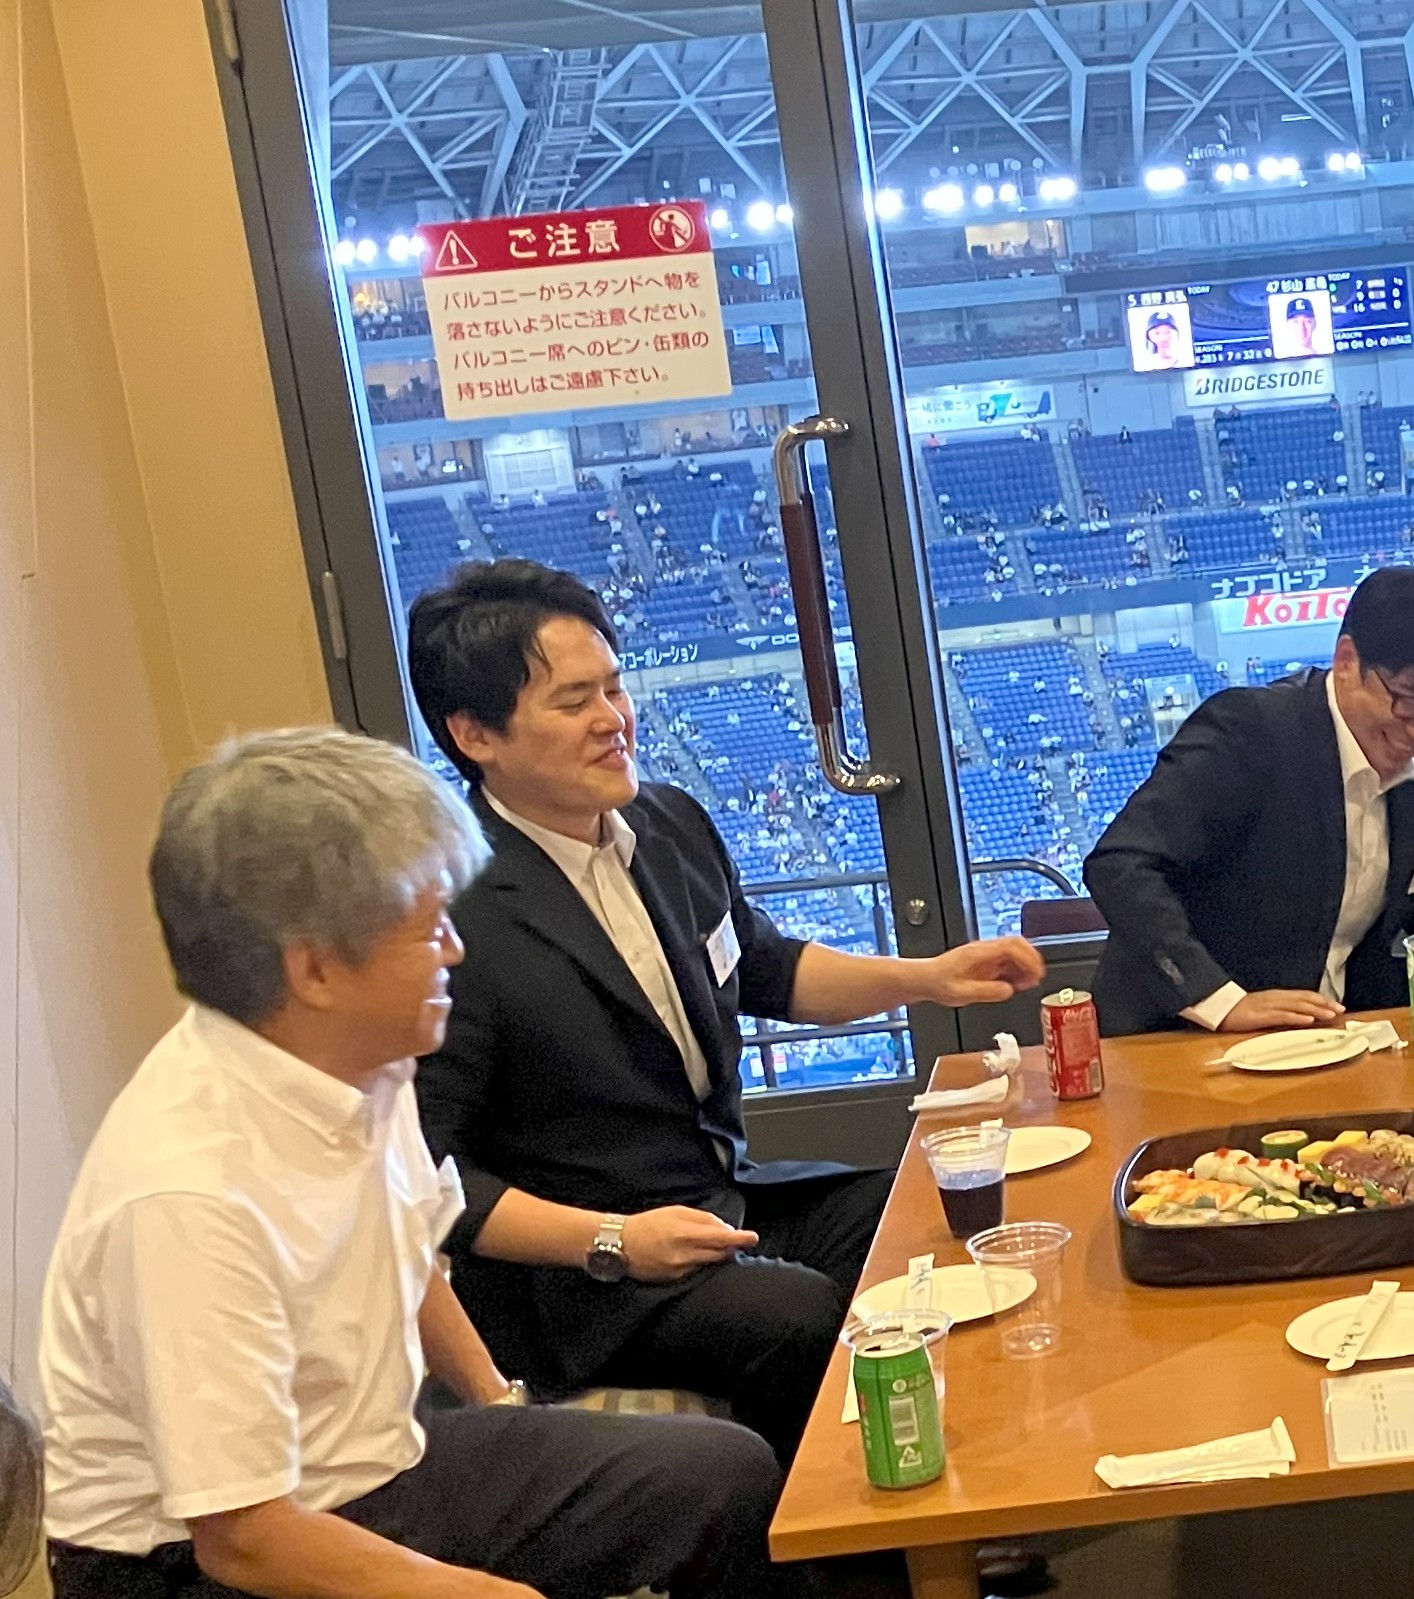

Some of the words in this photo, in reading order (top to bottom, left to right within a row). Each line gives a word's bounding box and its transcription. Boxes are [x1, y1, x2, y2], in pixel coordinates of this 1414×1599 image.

[508, 219, 621, 259] ご注意
[444, 271, 700, 311] バルコニーからスタンドへ物を
[447, 304, 706, 342] 落さないようにご注意ください。
[457, 366, 669, 402] 持ち出しはご遠慮下さい。
[1195, 369, 1325, 396] BRIDGESTONE
[1211, 568, 1327, 599] ナフコドア
